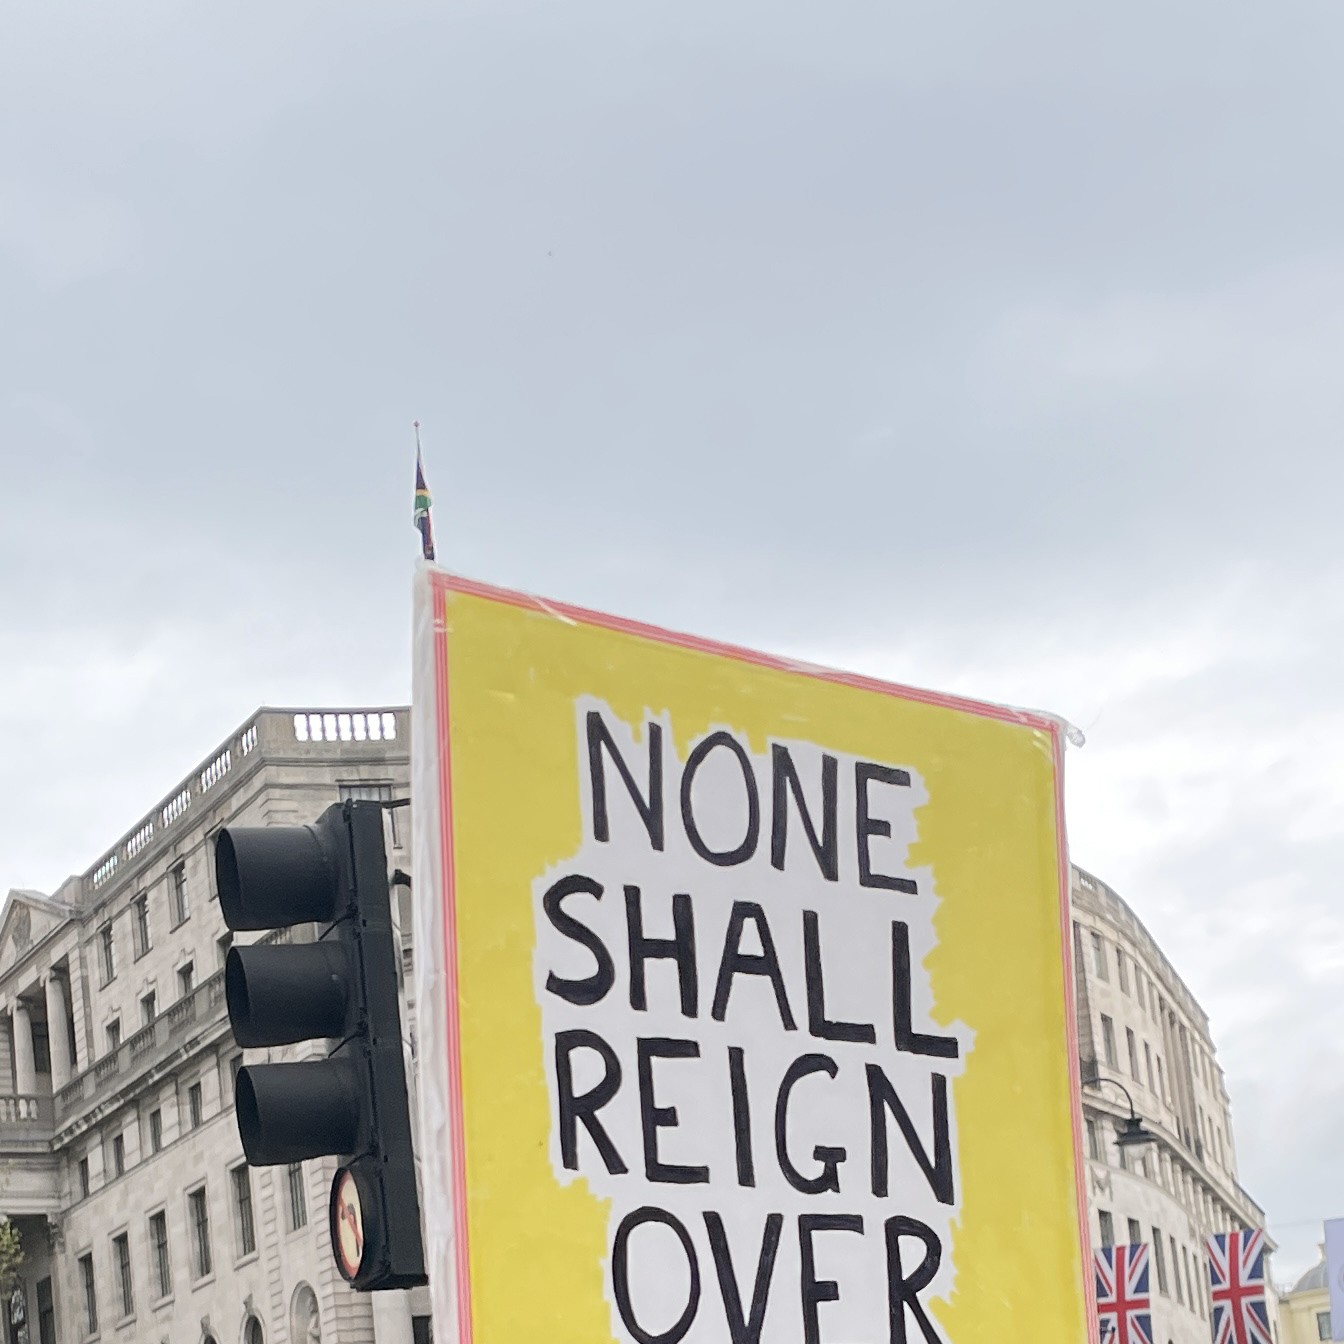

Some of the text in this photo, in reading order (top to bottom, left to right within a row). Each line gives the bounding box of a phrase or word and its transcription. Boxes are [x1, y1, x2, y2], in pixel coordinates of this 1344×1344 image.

[586, 711, 918, 894] NONE
[543, 874, 959, 1058] SHALL
[555, 1030, 957, 1205] REIGN
